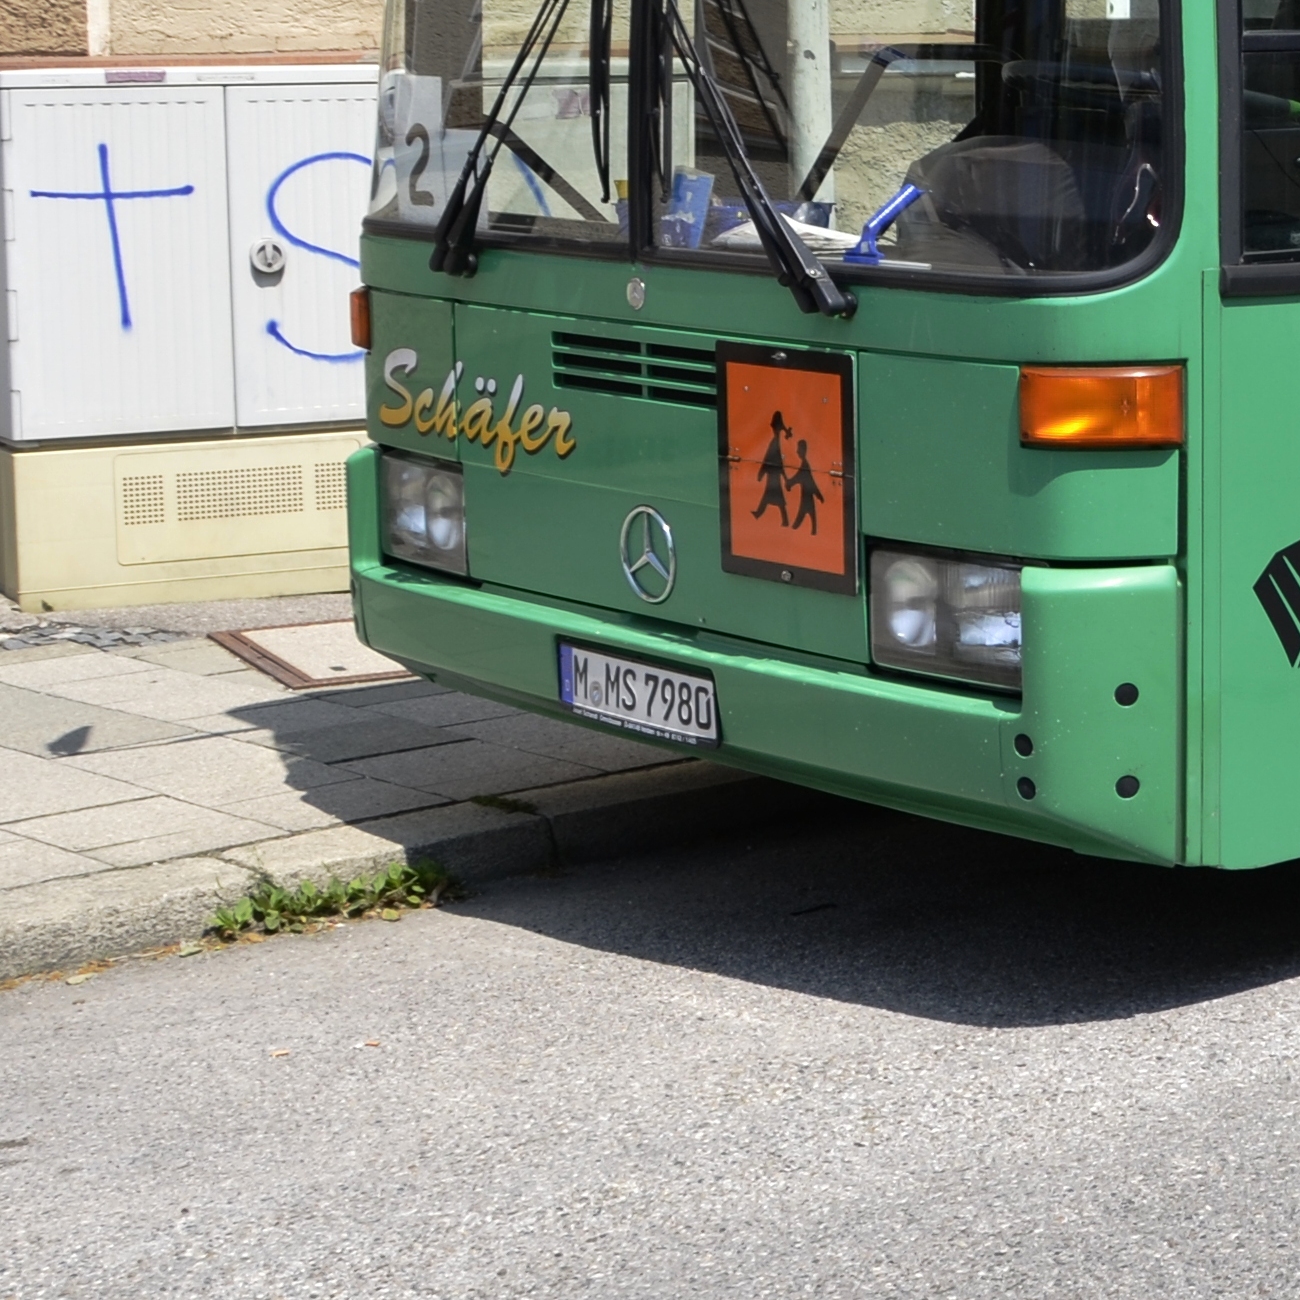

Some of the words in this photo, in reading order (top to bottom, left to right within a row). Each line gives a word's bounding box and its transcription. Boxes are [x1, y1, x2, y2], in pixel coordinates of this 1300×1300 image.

[405, 122, 435, 207] 2
[379, 347, 576, 474] Schäfer
[573, 654, 589, 699] M
[605, 662, 637, 712] MS
[644, 672, 712, 730] 7980
